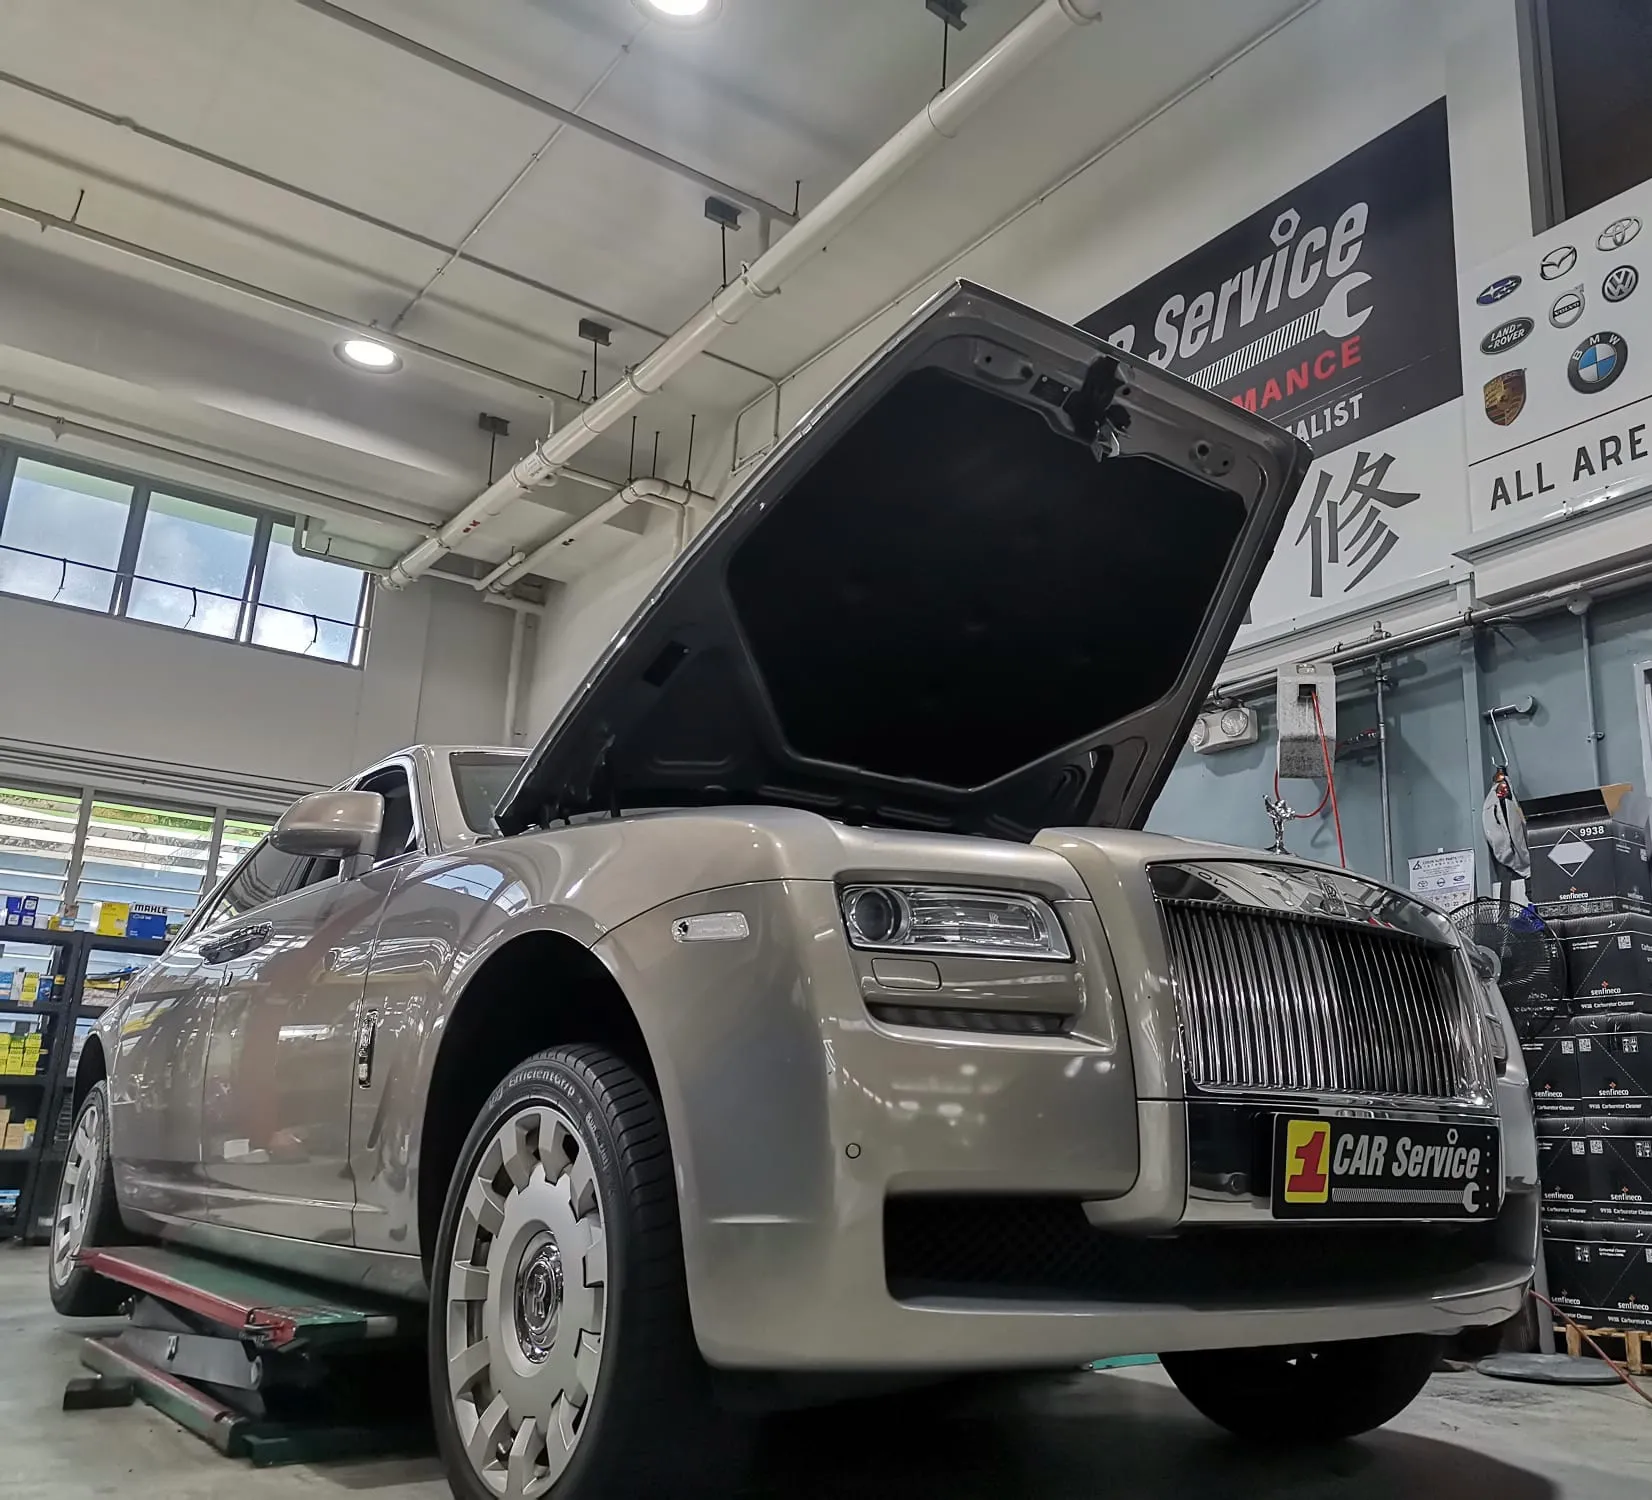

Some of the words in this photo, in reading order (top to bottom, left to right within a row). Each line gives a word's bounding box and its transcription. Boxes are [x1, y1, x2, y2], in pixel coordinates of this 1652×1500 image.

[1148, 202, 1369, 370] Service
[1490, 324, 1517, 342] LAND
[1493, 328, 1525, 350] ROVER
[1490, 462, 1555, 511] ALL
[1572, 424, 1649, 482] ARE
[1295, 451, 1421, 598] 修
[1579, 825, 1605, 837] 9938
[1559, 891, 1588, 900] senfineco
[134, 903, 168, 915] MAHLE
[1590, 987, 1621, 996] senfineco
[1534, 1090, 1563, 1098] senfineco
[1287, 1131, 1326, 1193] 1
[1332, 1133, 1388, 1176] CAR
[1391, 1129, 1480, 1179] Service
[1544, 1191, 1574, 1200] senfineco
[1610, 1193, 1642, 1201] senfineco
[1551, 1296, 1581, 1305] senfineco
[1617, 1301, 1650, 1311] senfineco
